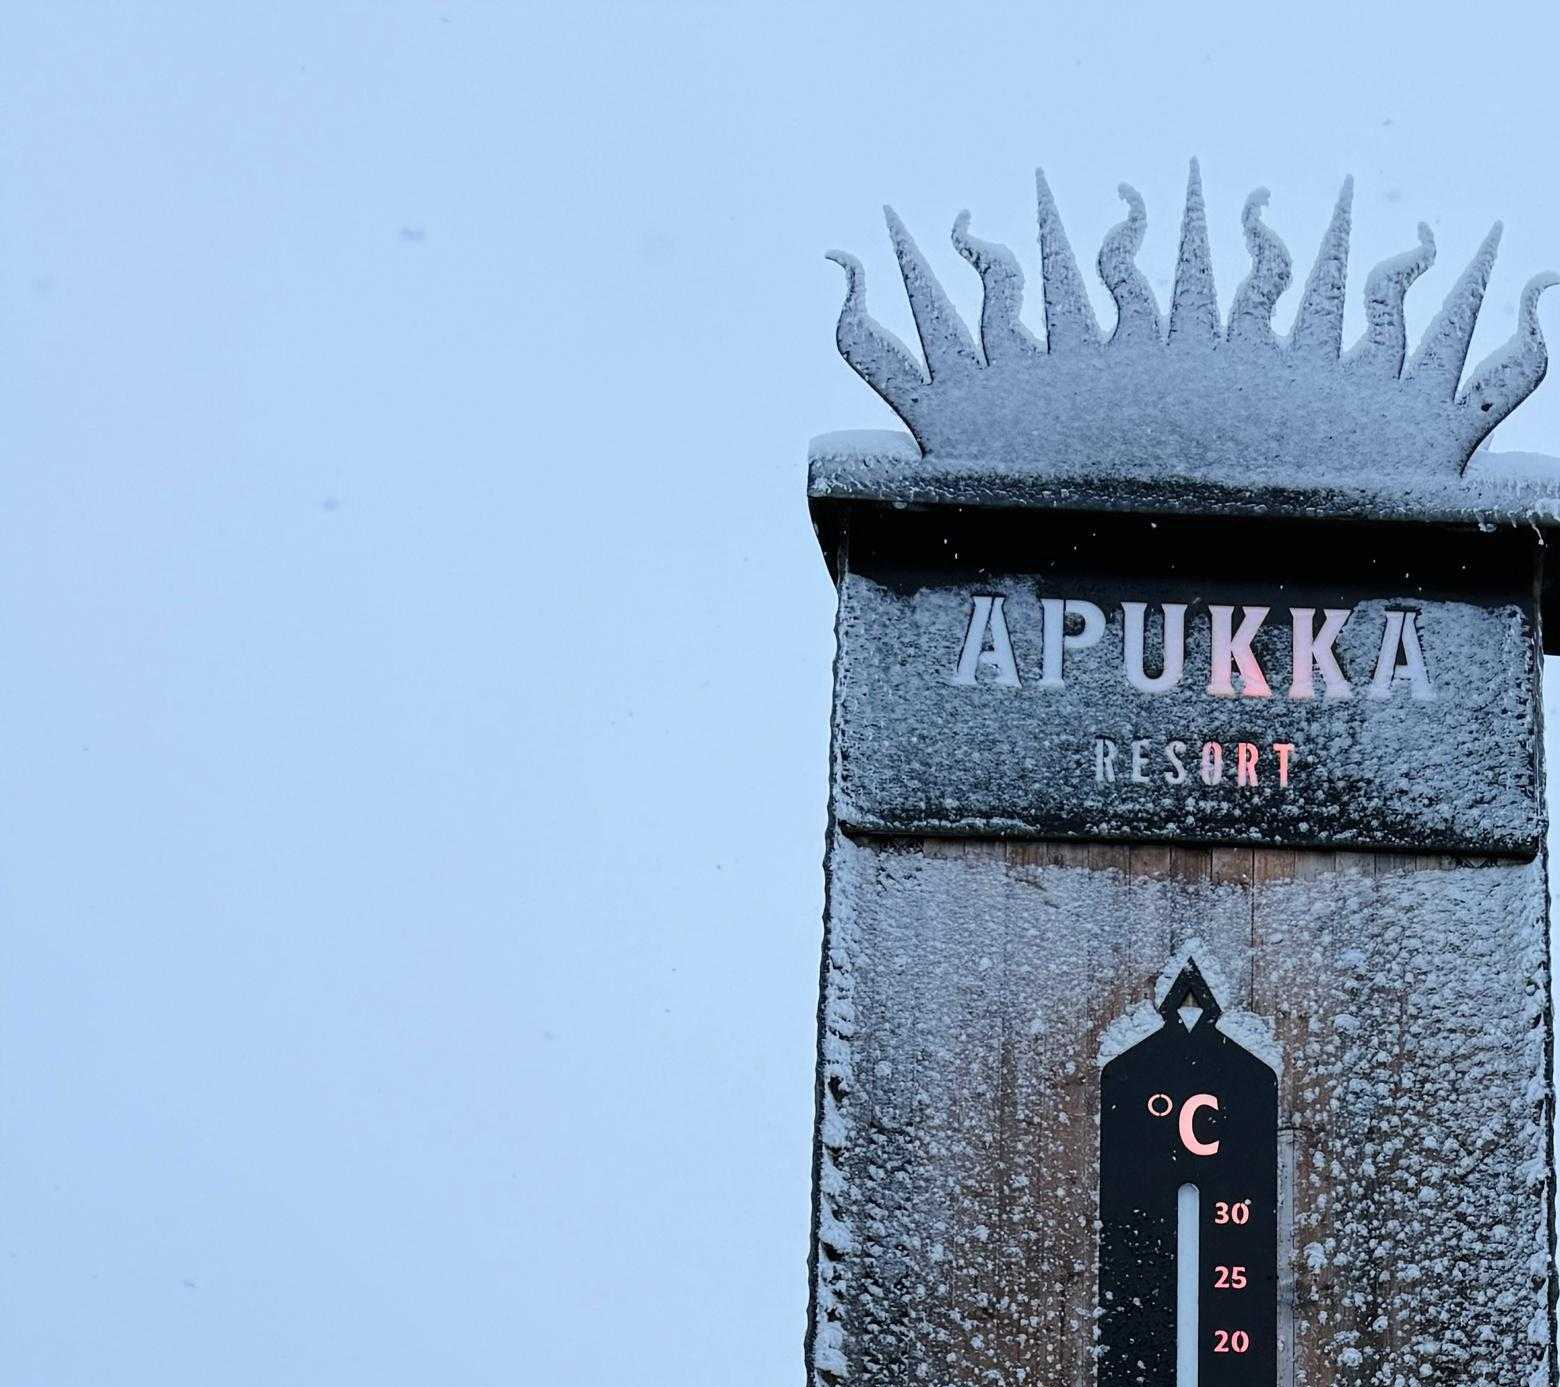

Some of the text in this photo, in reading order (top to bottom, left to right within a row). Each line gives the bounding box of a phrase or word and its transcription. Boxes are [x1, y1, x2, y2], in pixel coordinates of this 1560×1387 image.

[953, 594, 1436, 700] APUKKA
[1095, 738, 1296, 787] RESORT
[1215, 1203, 1250, 1225] 30
[1215, 1266, 1247, 1288] 25
[1214, 1330, 1249, 1353] 20
